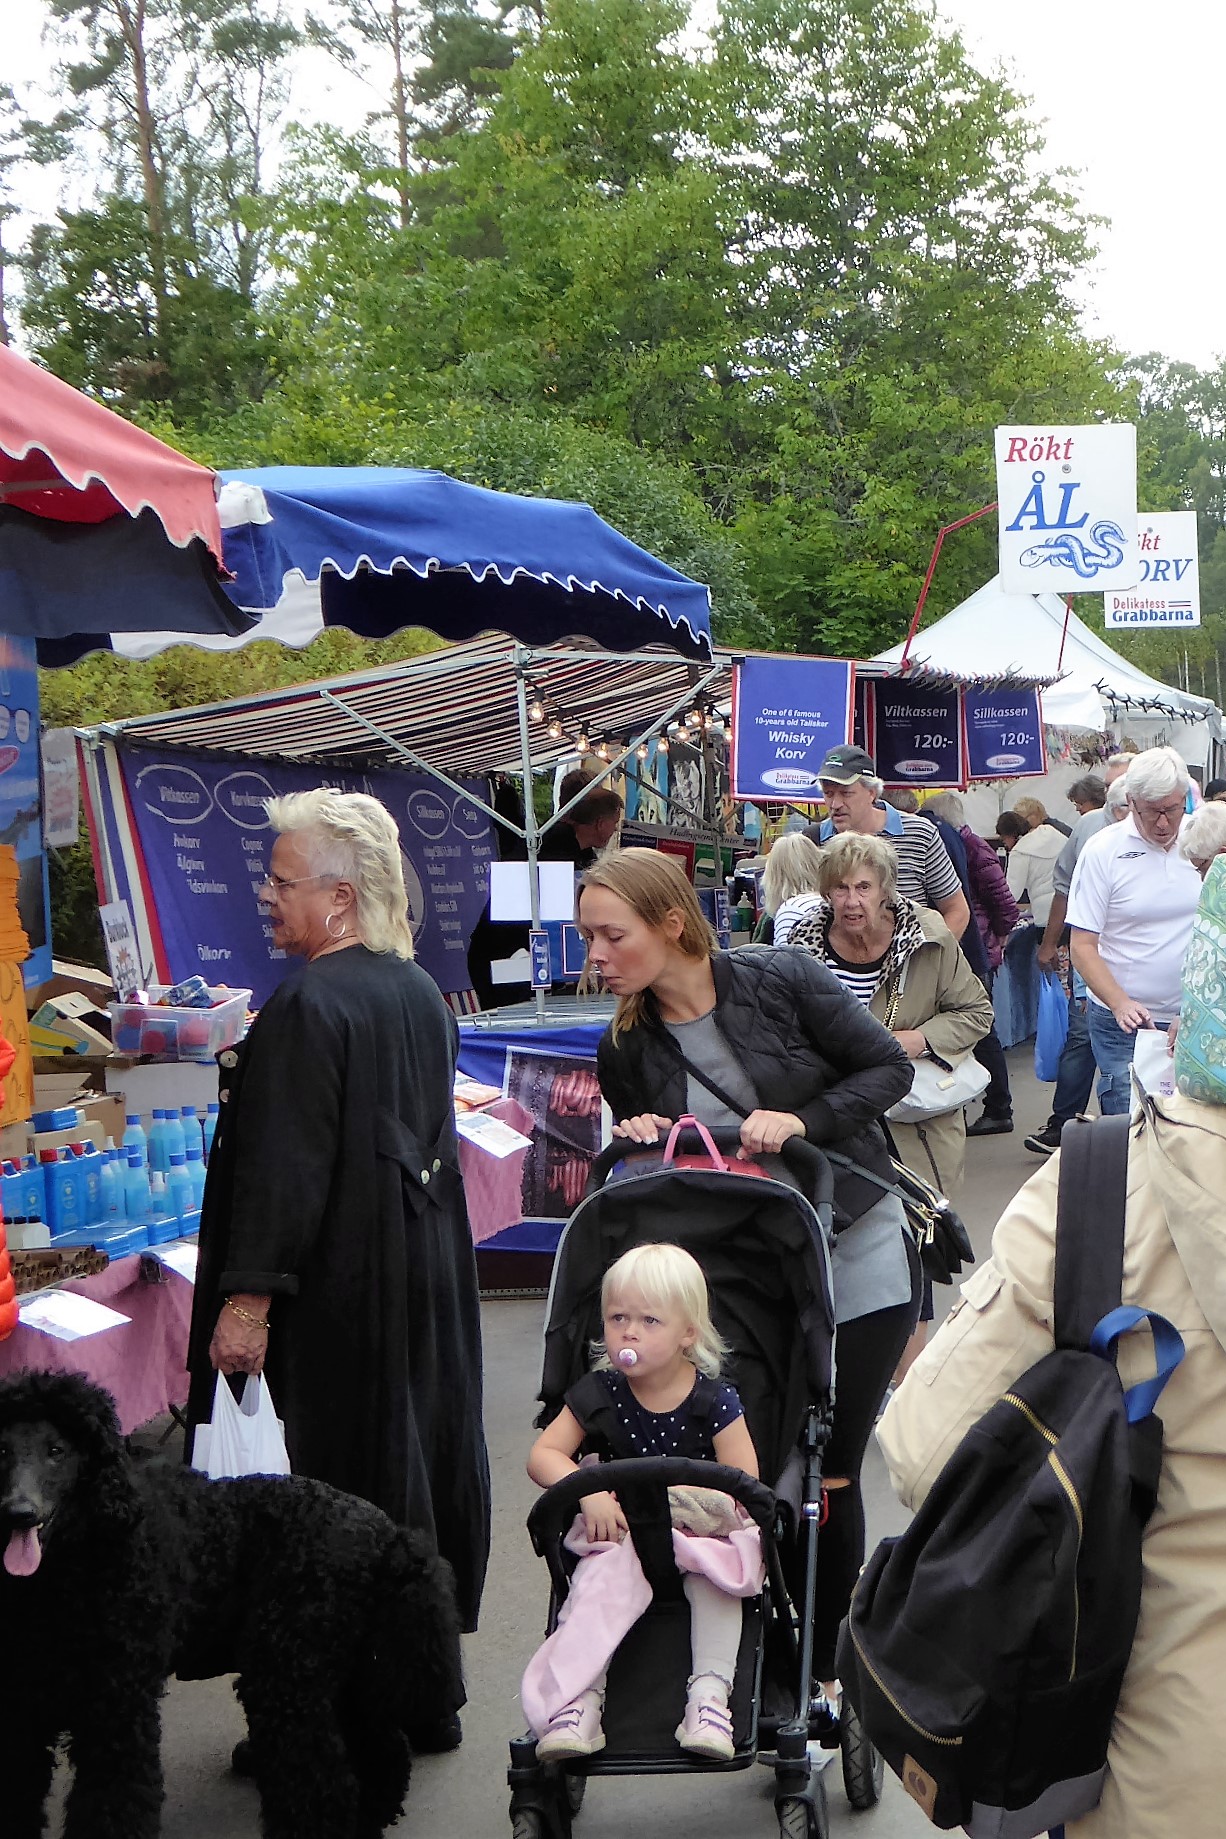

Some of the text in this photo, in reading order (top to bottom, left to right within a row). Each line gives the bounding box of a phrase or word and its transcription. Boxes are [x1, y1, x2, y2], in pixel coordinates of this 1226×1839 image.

[1004, 435, 1074, 463] Rökt
[1005, 470, 1090, 532] ÅL
[1138, 533, 1161, 551] kt
[1138, 558, 1194, 582] ORV
[1113, 597, 1166, 609] Delikatess
[1112, 609, 1194, 622] Grabbarna
[762, 708, 821, 719] One of 6 famous
[884, 705, 948, 718] Viltkassen
[973, 707, 1029, 720] Sillkassen
[754, 717, 829, 728] 10-years old Talisker
[768, 730, 815, 746] Whisky
[913, 734, 954, 748] 120:-
[1000, 732, 1035, 746] 120:-
[775, 747, 807, 760] Korv
